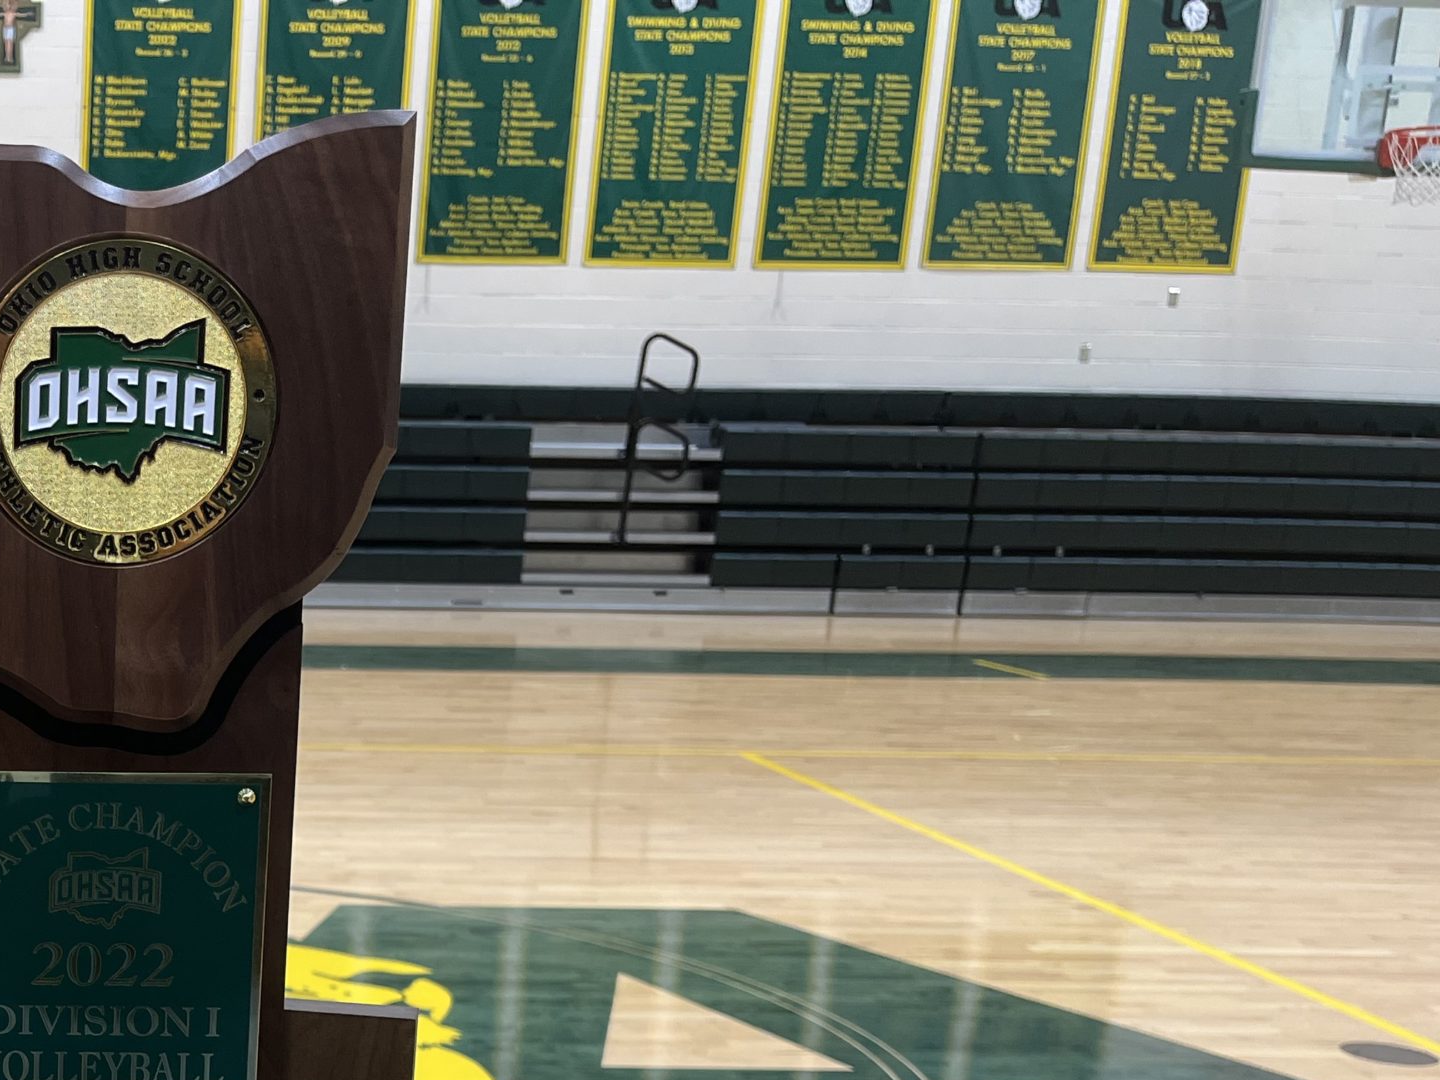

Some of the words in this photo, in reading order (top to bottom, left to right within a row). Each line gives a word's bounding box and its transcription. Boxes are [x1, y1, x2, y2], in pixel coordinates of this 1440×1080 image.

[132, 7, 194, 19] VOLLEYBALL
[307, 8, 369, 20] VOLLEYBALL
[479, 12, 541, 25] VOLLEYBALL
[114, 19, 144, 31] STATE
[146, 20, 212, 33] CHAMPIONS
[288, 21, 318, 33] STATE
[320, 22, 386, 35] CHAMPIONS
[461, 25, 489, 38] STATE
[492, 26, 558, 39] CHAMPIONS
[996, 22, 1057, 36] VOLLEYBALL
[634, 29, 663, 41] STATE
[665, 30, 731, 43] CHAMPIONS
[808, 32, 837, 45] STATE
[839, 33, 904, 46] CHAMPIONS
[978, 34, 1006, 47] STATE
[1008, 36, 1072, 50] CHAMPIONS
[1165, 31, 1221, 45] VOLLEYBALL
[1148, 43, 1175, 56] STATE
[1176, 44, 1235, 59] CHAMPIONS
[65, 247, 142, 278] HIGH
[156, 252, 254, 342] SCHOOL
[27, 367, 216, 436] OHSAA
[95, 437, 266, 558] ASSOCIATION
[68, 803, 248, 913] CHAMPION
[58, 869, 159, 905] OHSAA
[30, 942, 175, 988] 2022
[205, 1007, 221, 1038] I
